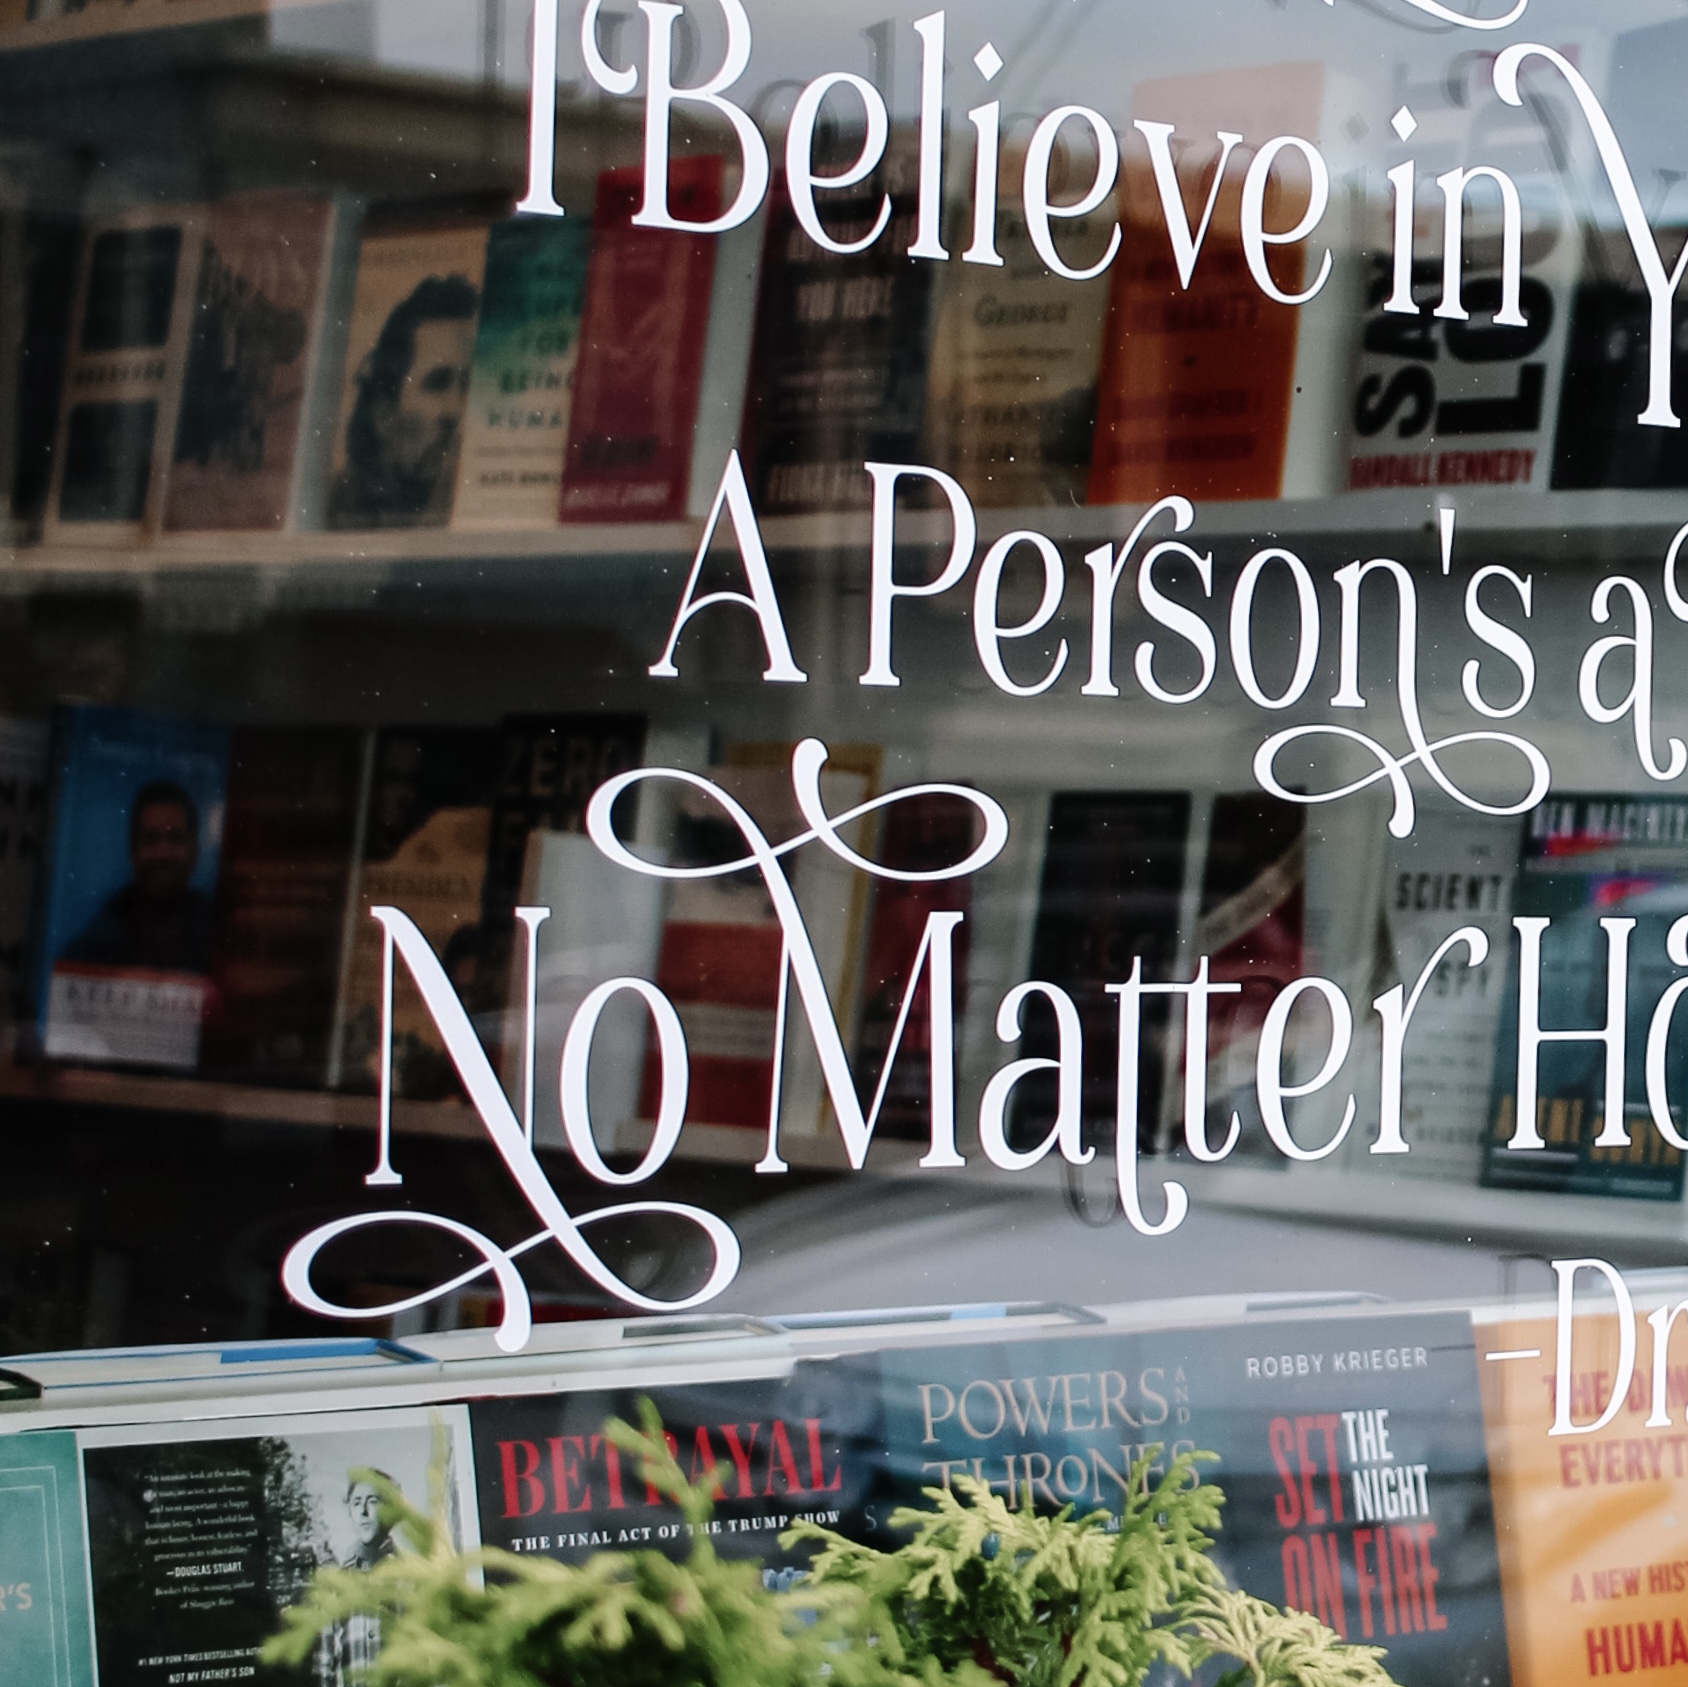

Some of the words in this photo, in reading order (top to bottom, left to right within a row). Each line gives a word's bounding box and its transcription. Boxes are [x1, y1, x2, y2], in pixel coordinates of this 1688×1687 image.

[1382, 104, 1529, 328] in
[648, 448, 808, 684] A
[858, 461, 1551, 839] Person's
[282, 905, 741, 1354] No
[586, 737, 1489, 1237] Matter
[918, 1367, 1170, 1445] POWERS
[1246, 1353, 1324, 1378] ROBBY
[1334, 1346, 1429, 1372] KRIEGER
[1268, 1414, 1344, 1529] SET
[1342, 1408, 1395, 1462] THE
[1353, 1463, 1430, 1522] NIGHT
[512, 1535, 551, 1552] THE
[557, 1530, 612, 1549] FINAL
[618, 1525, 651, 1543] ACT
[658, 1523, 681, 1539] OF
[728, 1514, 788, 1533] TRUMP
[1281, 1531, 1347, 1642] ON
[1353, 1522, 1448, 1639] FIRE
[1570, 1572, 1586, 1604] A
[1592, 1567, 1642, 1601] NEW
